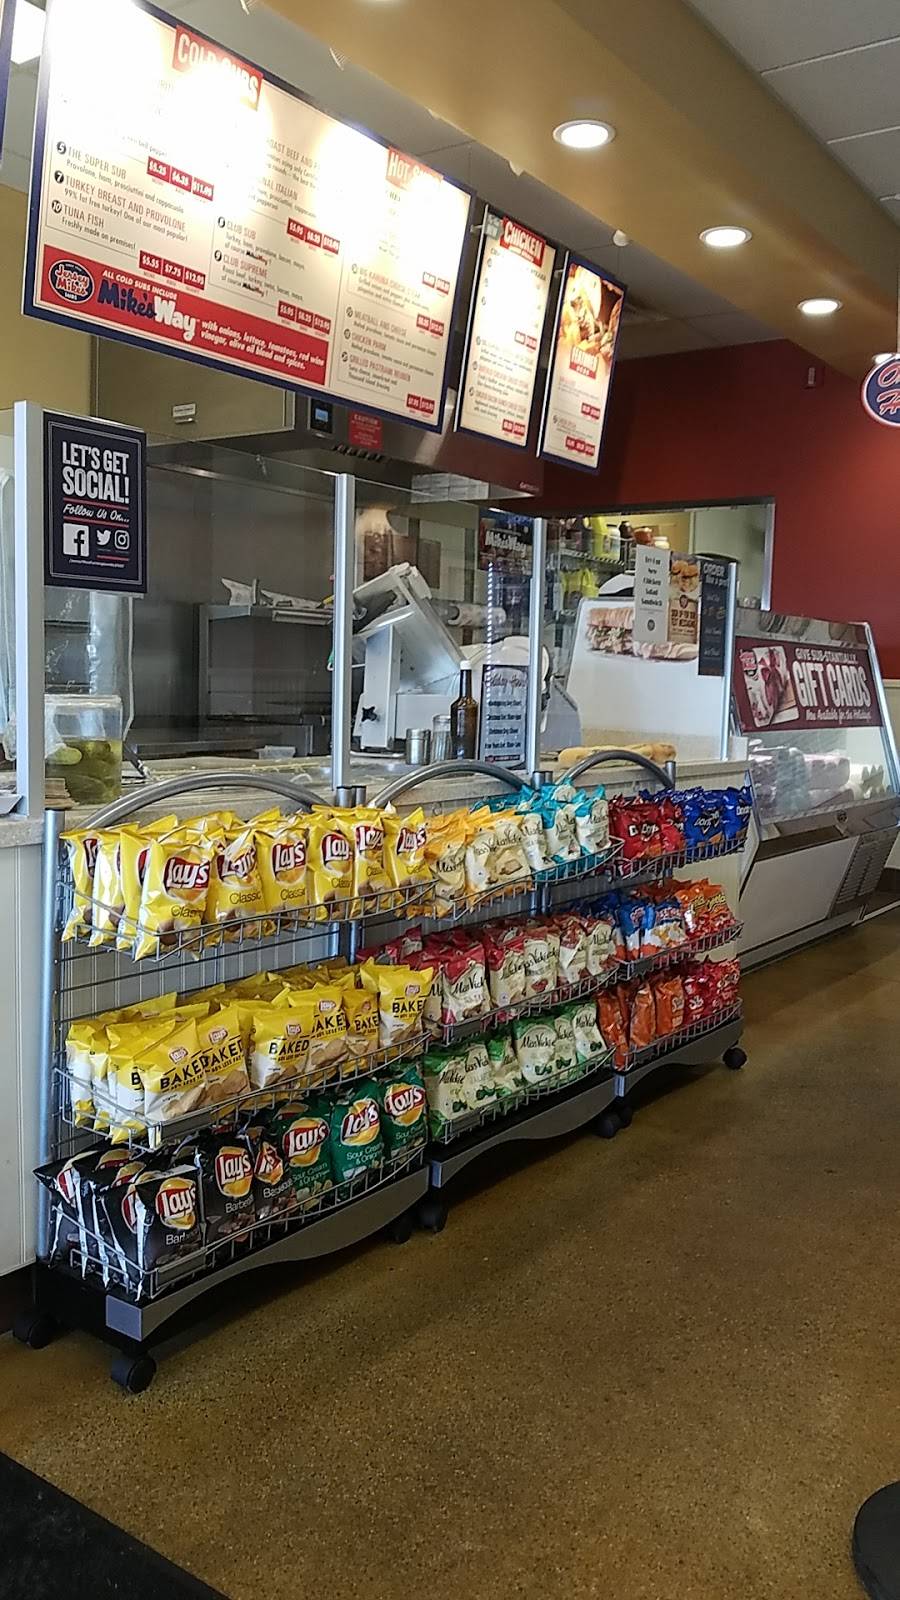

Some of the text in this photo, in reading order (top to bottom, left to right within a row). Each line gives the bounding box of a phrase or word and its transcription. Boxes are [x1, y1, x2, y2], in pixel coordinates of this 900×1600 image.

[68, 146, 127, 180] THE SUPER SUB
[286, 147, 299, 161] BEEF
[388, 151, 409, 180] HOT
[64, 188, 77, 201] 99%
[102, 202, 122, 219] turkey!
[65, 175, 186, 232] TURKEY BREAST AND PROVOLONE
[276, 183, 298, 201] ITALIAN
[61, 217, 82, 232] Freshly
[84, 226, 100, 238] made
[101, 232, 109, 240] on
[64, 204, 104, 229] TUNA FISH
[226, 220, 256, 240] CLUB SUB
[504, 221, 543, 260] CHICKEN
[55, 264, 90, 288] Jersey
[142, 255, 160, 269] $5.55
[165, 263, 182, 277] $7.75
[185, 270, 204, 286] $12.95
[224, 254, 239, 268] CLUB
[240, 260, 268, 278] SUPREME
[102, 269, 114, 280] ALL
[115, 273, 133, 286] COLD
[134, 280, 151, 293] SUBS
[152, 285, 178, 301] INCLUDE
[97, 278, 157, 319] Mike's
[153, 295, 196, 341] Way
[200, 330, 306, 370] vinegar, olive oil blend and spices.
[201, 320, 325, 367] with onions, lettuce, tomatoes, red wine
[62, 441, 129, 475] LET'S GET
[62, 466, 130, 504] SOCIAL!
[63, 503, 130, 523] Follow Us On...
[703, 563, 725, 577] ORDER
[641, 598, 662, 607] Sandwich
[646, 588, 658, 596] Salad
[792, 660, 871, 707] GIFT CARDS
[324, 838, 353, 862] Lay
[399, 826, 427, 853] Lay's
[275, 841, 306, 872] Lay's
[166, 861, 211, 889] Lay's
[229, 889, 261, 905] Classic
[171, 905, 203, 918] Clas
[452, 981, 469, 995] Miss
[392, 1000, 423, 1014] BAKE
[355, 1015, 379, 1031] BAKE
[269, 1040, 310, 1055] BAKED
[522, 1036, 537, 1048] Miss
[389, 1086, 424, 1116] Lay's
[288, 1125, 329, 1157] Lay's
[396, 1130, 411, 1141] Sour
[219, 1153, 252, 1183] Lay's
[346, 1151, 363, 1161] Sour
[292, 1162, 328, 1181] Sour Cream
[225, 1196, 253, 1214] Barbe
